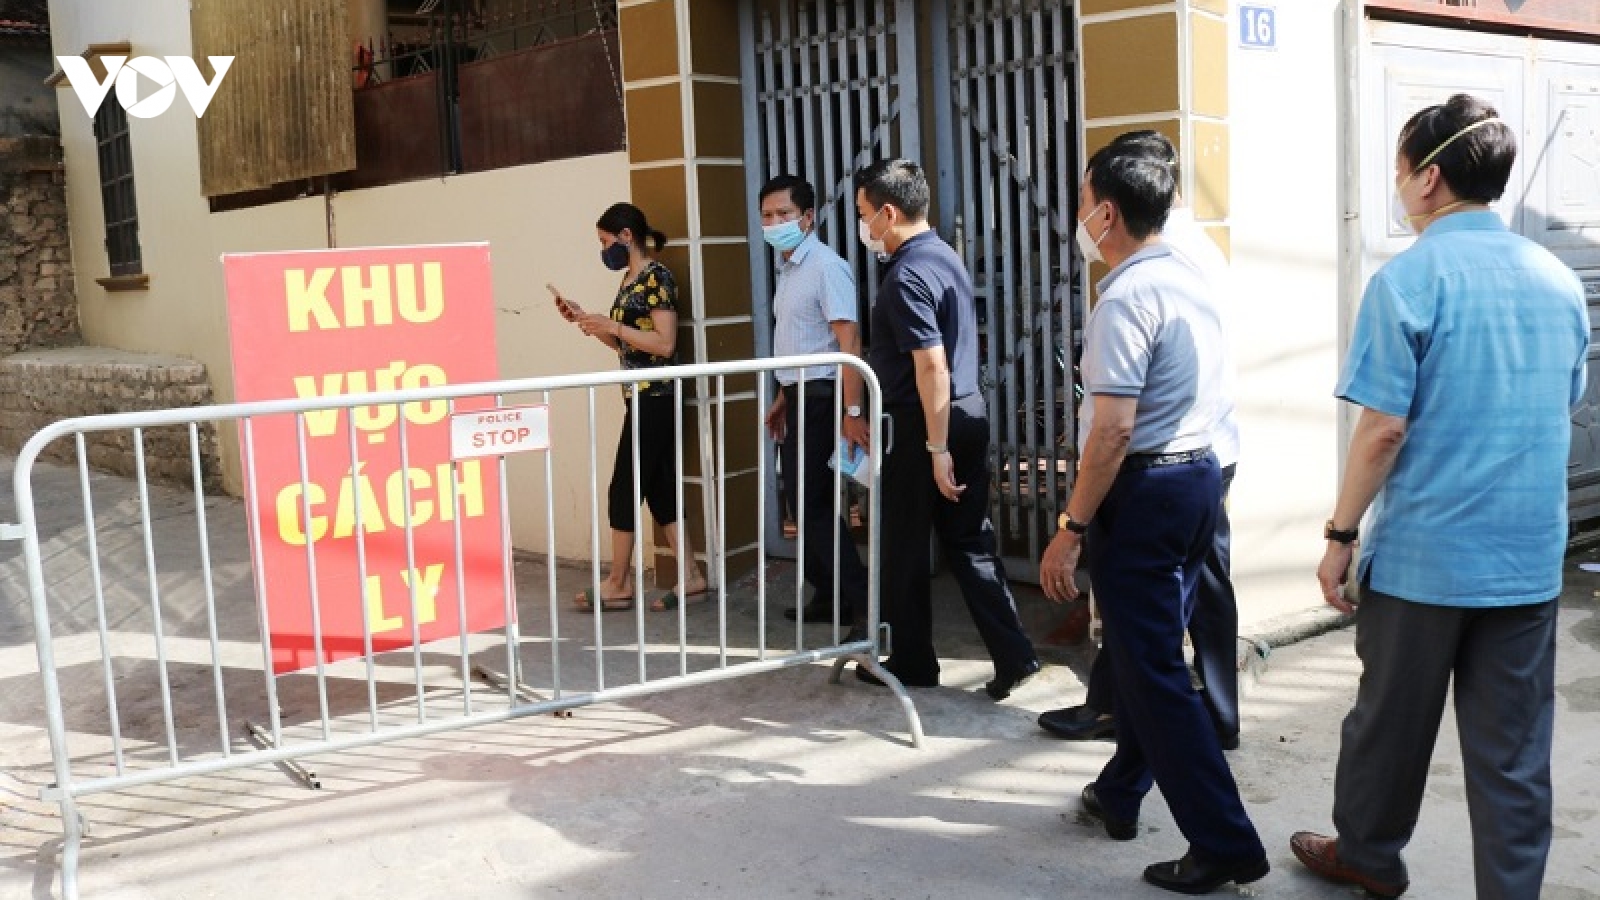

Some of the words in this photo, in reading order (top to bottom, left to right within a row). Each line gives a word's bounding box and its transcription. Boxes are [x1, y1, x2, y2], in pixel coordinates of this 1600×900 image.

[1246, 9, 1271, 43] 16
[284, 261, 445, 332] KHU
[471, 427, 531, 448] STOP
[477, 411, 523, 425] POLICE
[275, 459, 485, 546] CÁCH
[362, 562, 445, 634] LY
